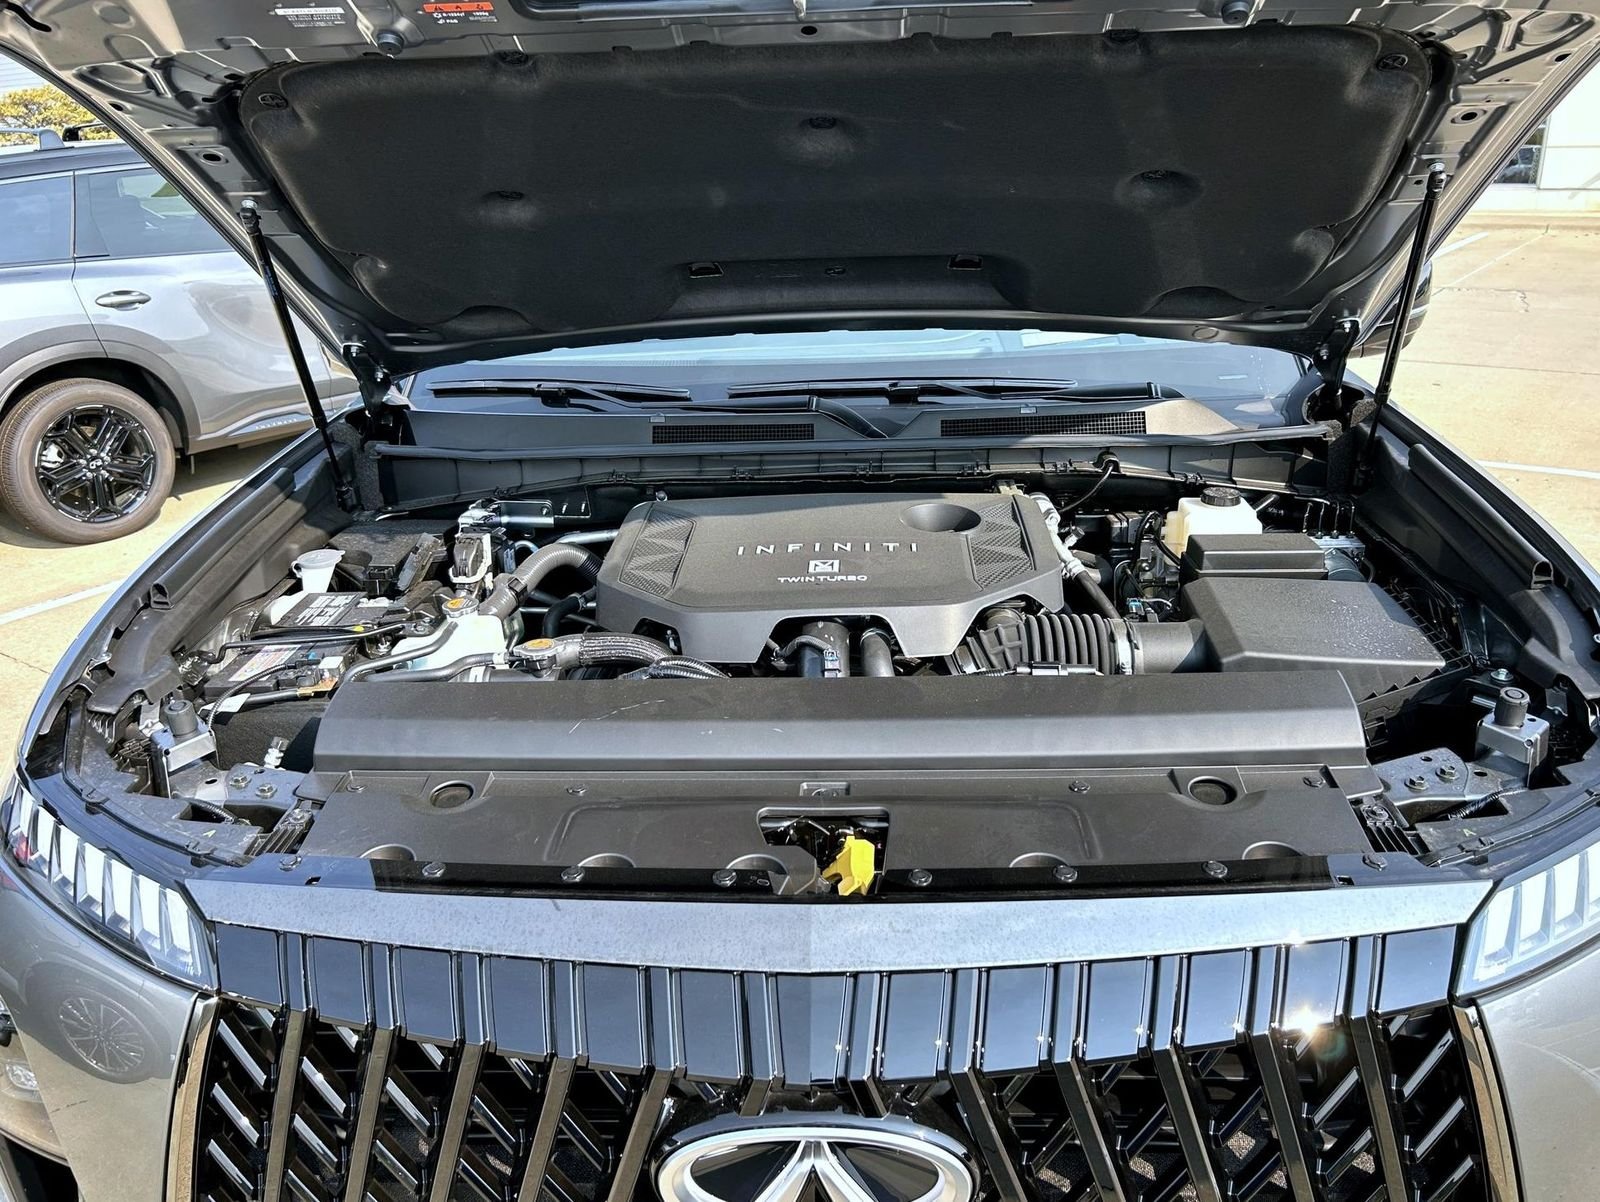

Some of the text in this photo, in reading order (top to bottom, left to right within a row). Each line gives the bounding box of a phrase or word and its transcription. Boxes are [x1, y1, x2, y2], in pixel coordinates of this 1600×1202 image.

[736, 542, 919, 556] INFINITI
[777, 574, 868, 583] TWIN TURBO
